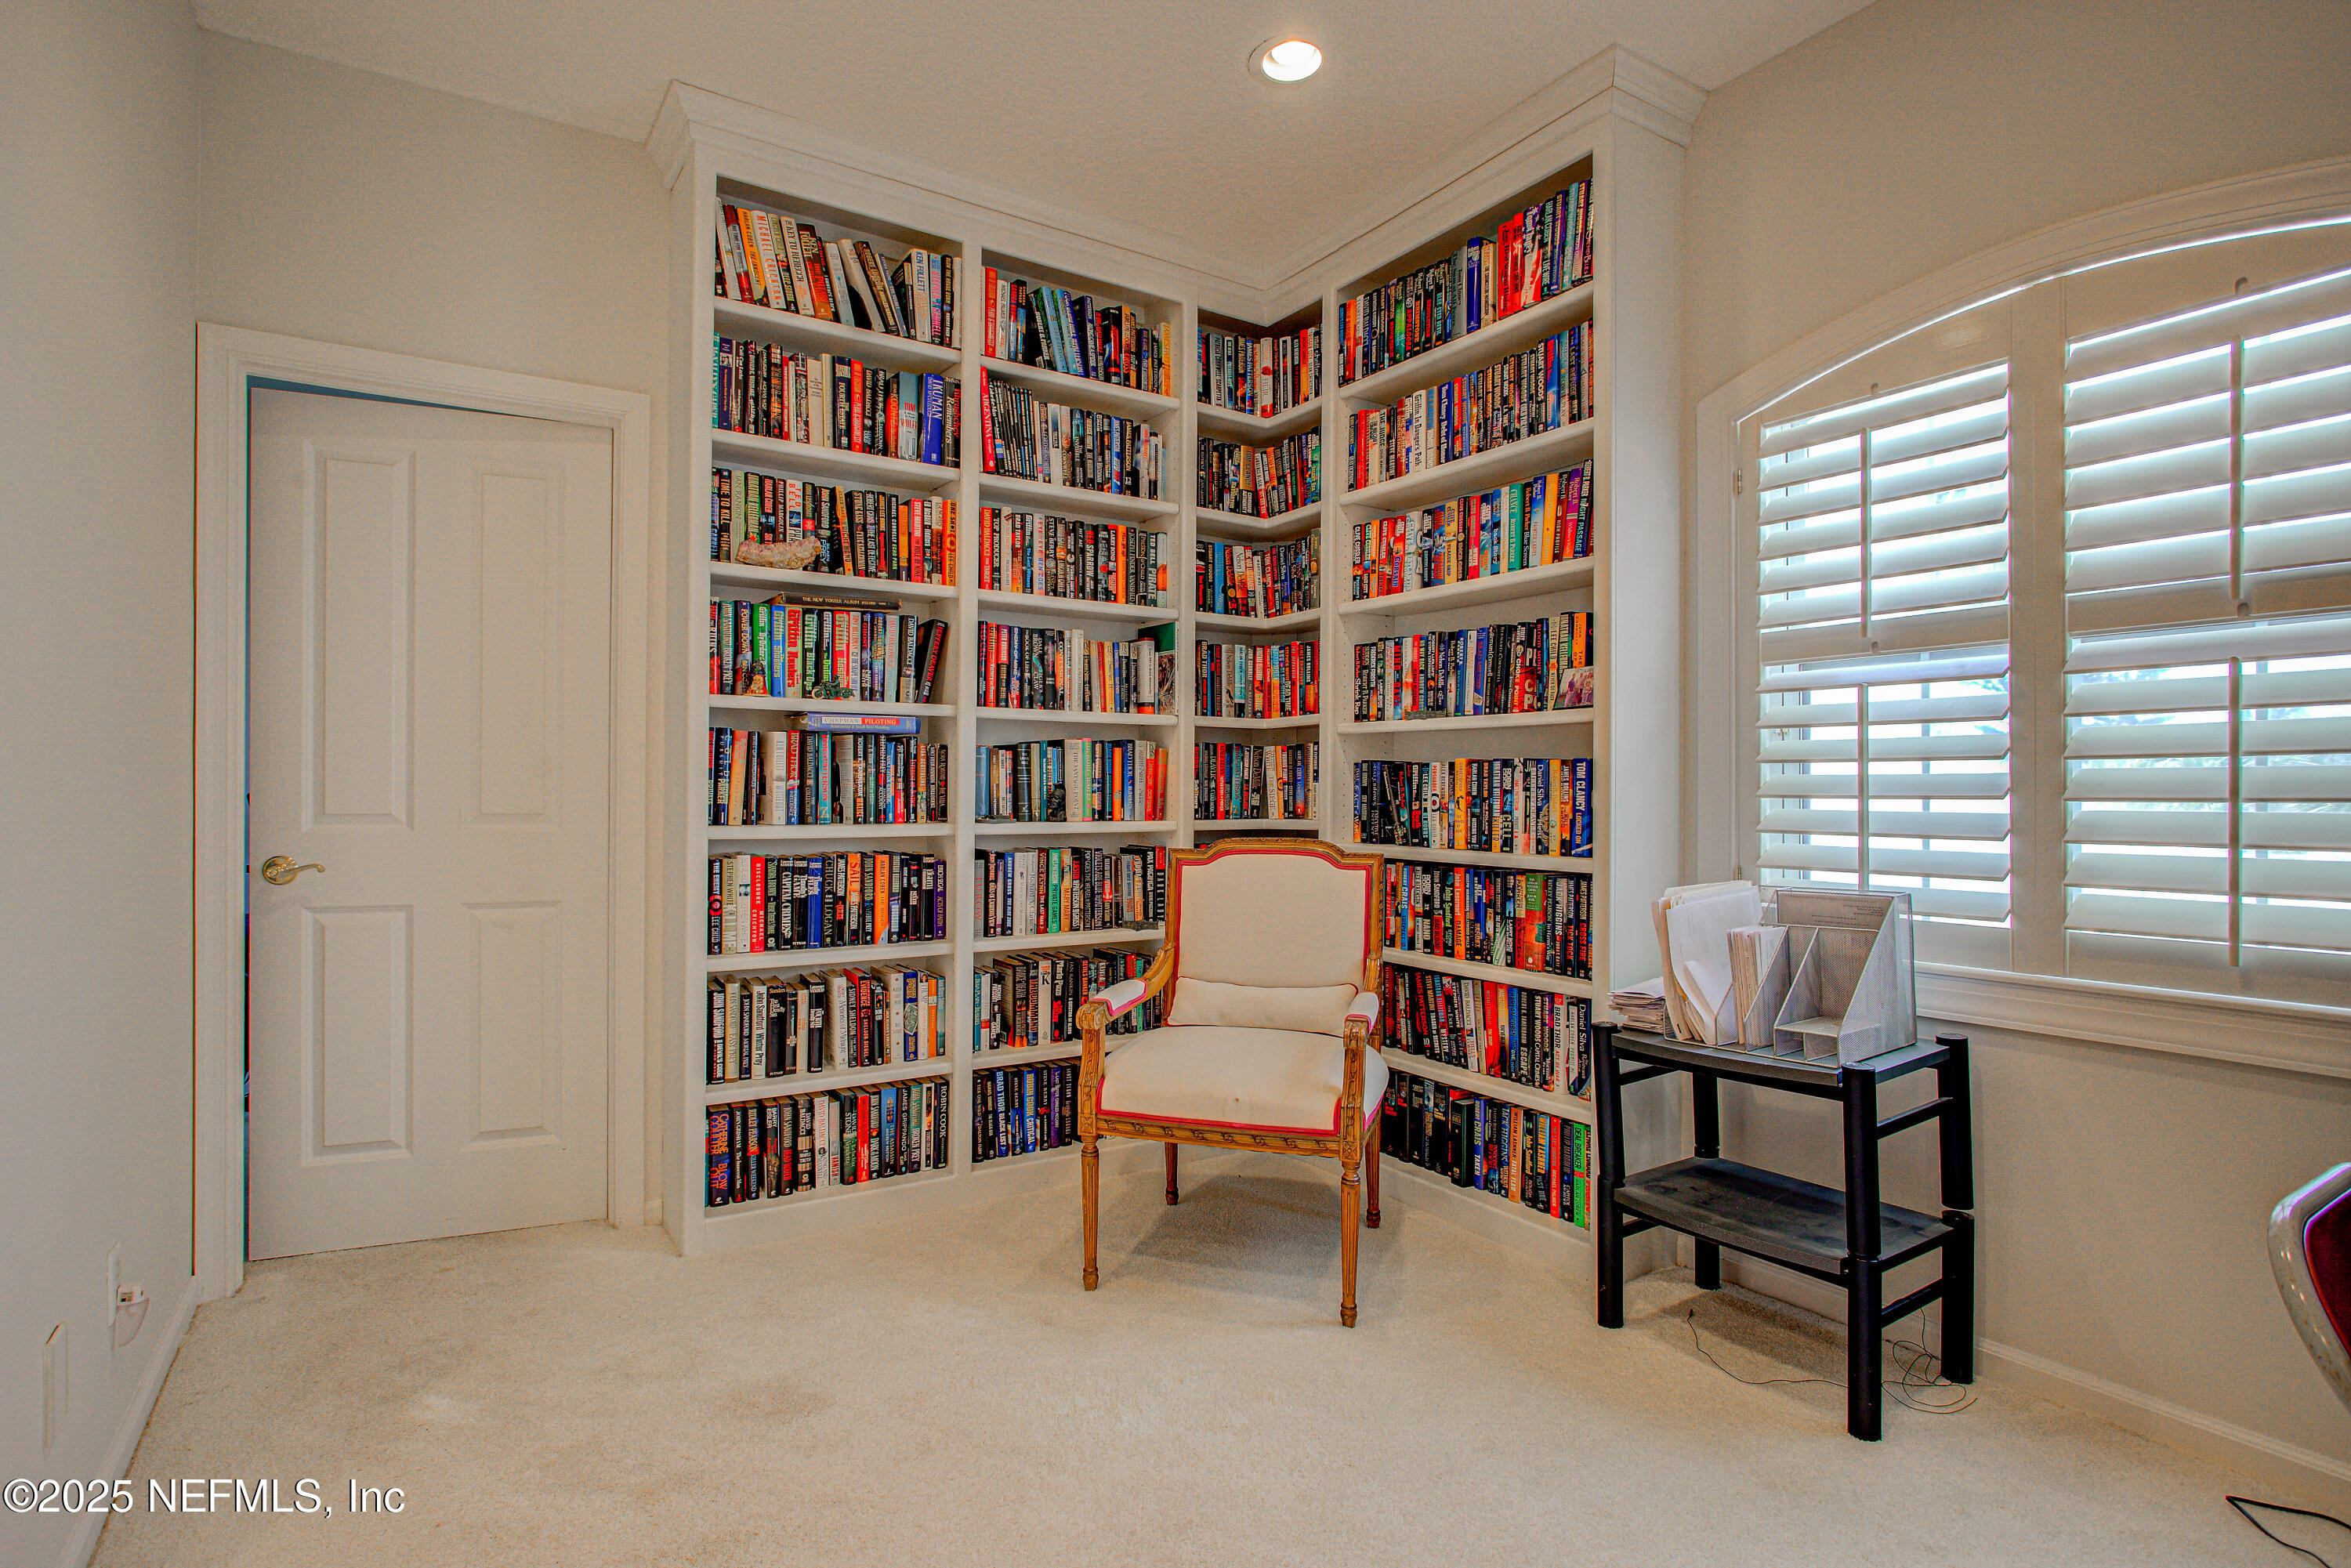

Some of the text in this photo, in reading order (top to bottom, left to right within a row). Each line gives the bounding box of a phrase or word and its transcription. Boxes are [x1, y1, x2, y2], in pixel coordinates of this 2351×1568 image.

[756, 214, 781, 301] MICHAEL CRICHTON
[799, 230, 818, 259] KEN FOLLETT
[915, 265, 925, 292] FOLLETT
[904, 401, 915, 411] TOM
[945, 395, 954, 444] Remembers
[982, 393, 992, 438] ARGENTINA
[820, 487, 829, 529] JOHN SANDFORD
[1509, 488, 1518, 514] CHANCE
[1392, 555, 1401, 587] CORSAIR
[926, 626, 944, 681] JEFFERY DEAVER
[789, 732, 798, 778] BRAD THOR
[1576, 761, 1585, 778] TOM
[716, 778, 725, 804] PARKER
[1575, 780, 1585, 810] CLANCY
[1502, 814, 1511, 840] CELL
[1574, 835, 1581, 844] ON
[781, 871, 790, 932] CAPITAL CRIMES
[824, 860, 833, 935] CHUCK LOGAN
[1578, 879, 1587, 894] JAMES
[1554, 882, 1563, 936] JACK HIGGINS
[1578, 922, 1587, 942] CROSS
[1578, 943, 1587, 961] FIRE
[1016, 965, 1026, 998] DANCE DEATH
[753, 990, 765, 1066] John Sandford Winter Prey
[1578, 1003, 1587, 1030] Daniel
[1440, 1027, 1449, 1052] MYSTERY
[996, 1091, 1005, 1112] THOR
[709, 1114, 719, 1156] COULTER
[719, 1113, 728, 1154] CATHERINE
[1500, 1125, 1509, 1162] HIGGINS
[1537, 1116, 1546, 1174] WILLIAM LASHNER
[709, 1167, 719, 1187] OUT
[718, 1162, 726, 1190] BLOW
